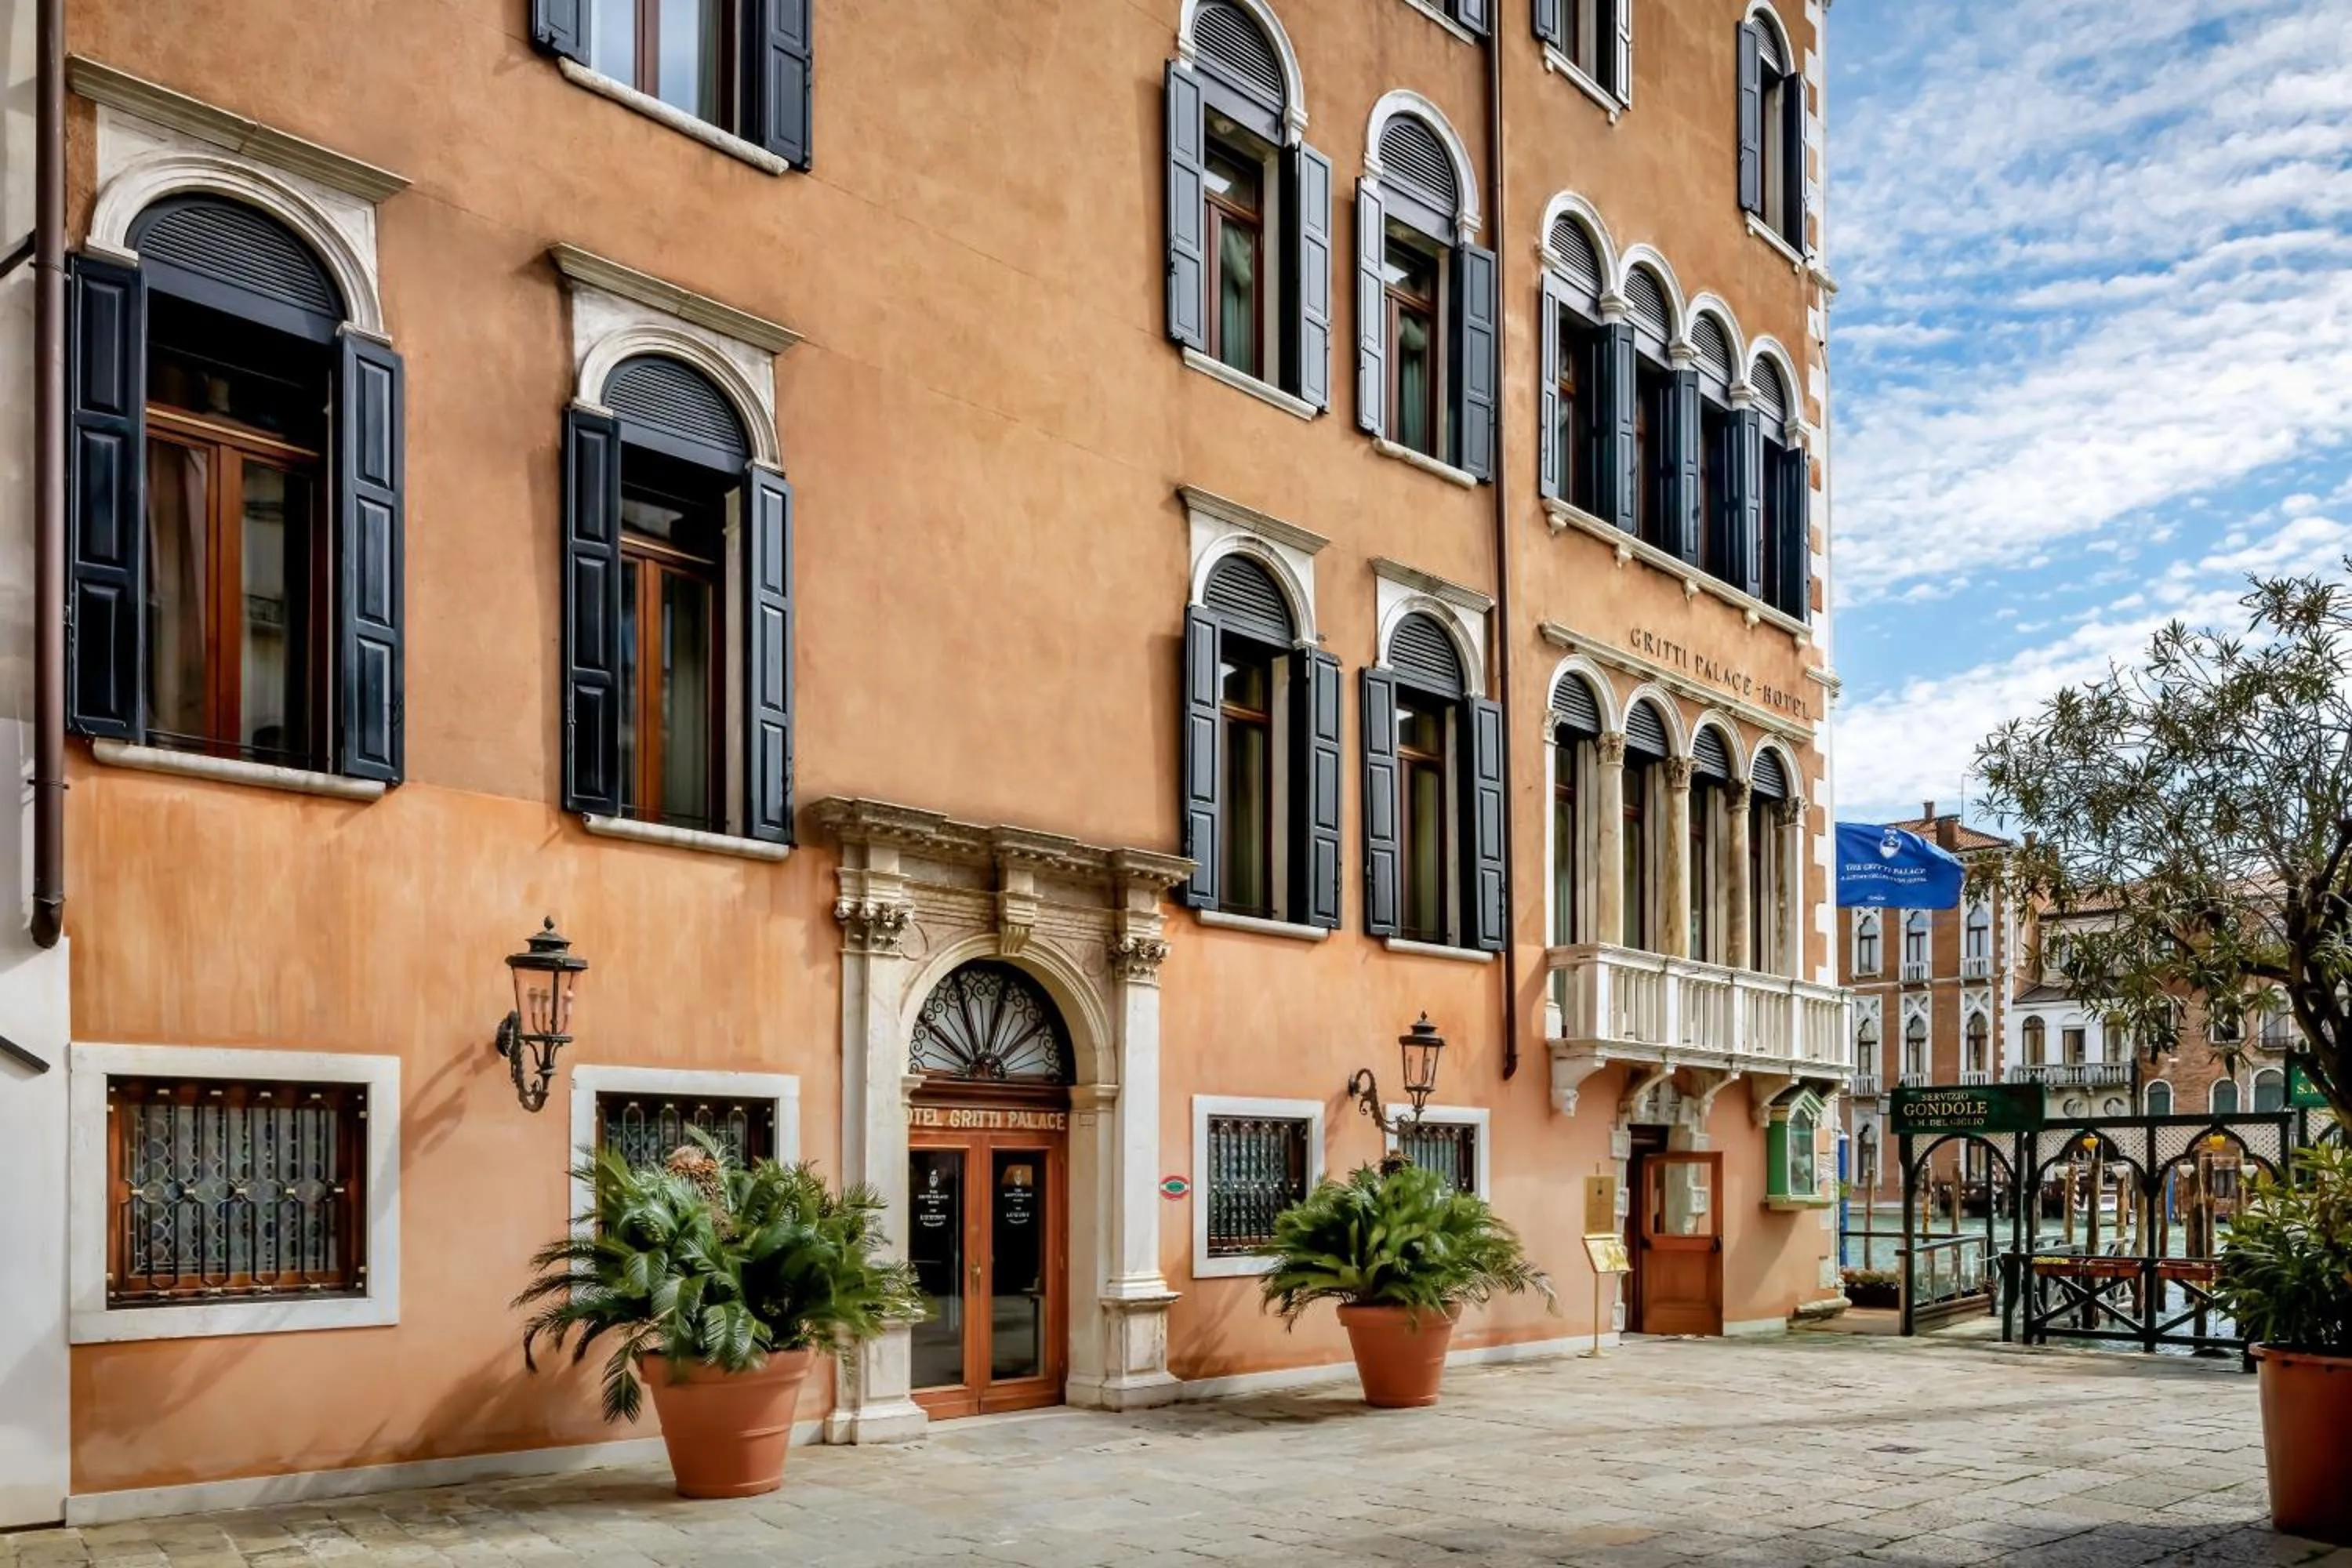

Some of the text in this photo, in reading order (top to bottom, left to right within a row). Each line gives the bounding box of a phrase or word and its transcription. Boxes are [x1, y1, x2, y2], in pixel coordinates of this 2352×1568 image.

[1630, 628, 1686, 669] GRITTI
[1695, 654, 1752, 696] PALACE
[1921, 1091, 1969, 1102] SERVIZIO
[1903, 1101, 1988, 1116] GONDOLE
[949, 1109, 1002, 1128] GRITTI
[1008, 1111, 1066, 1131] PALACE
